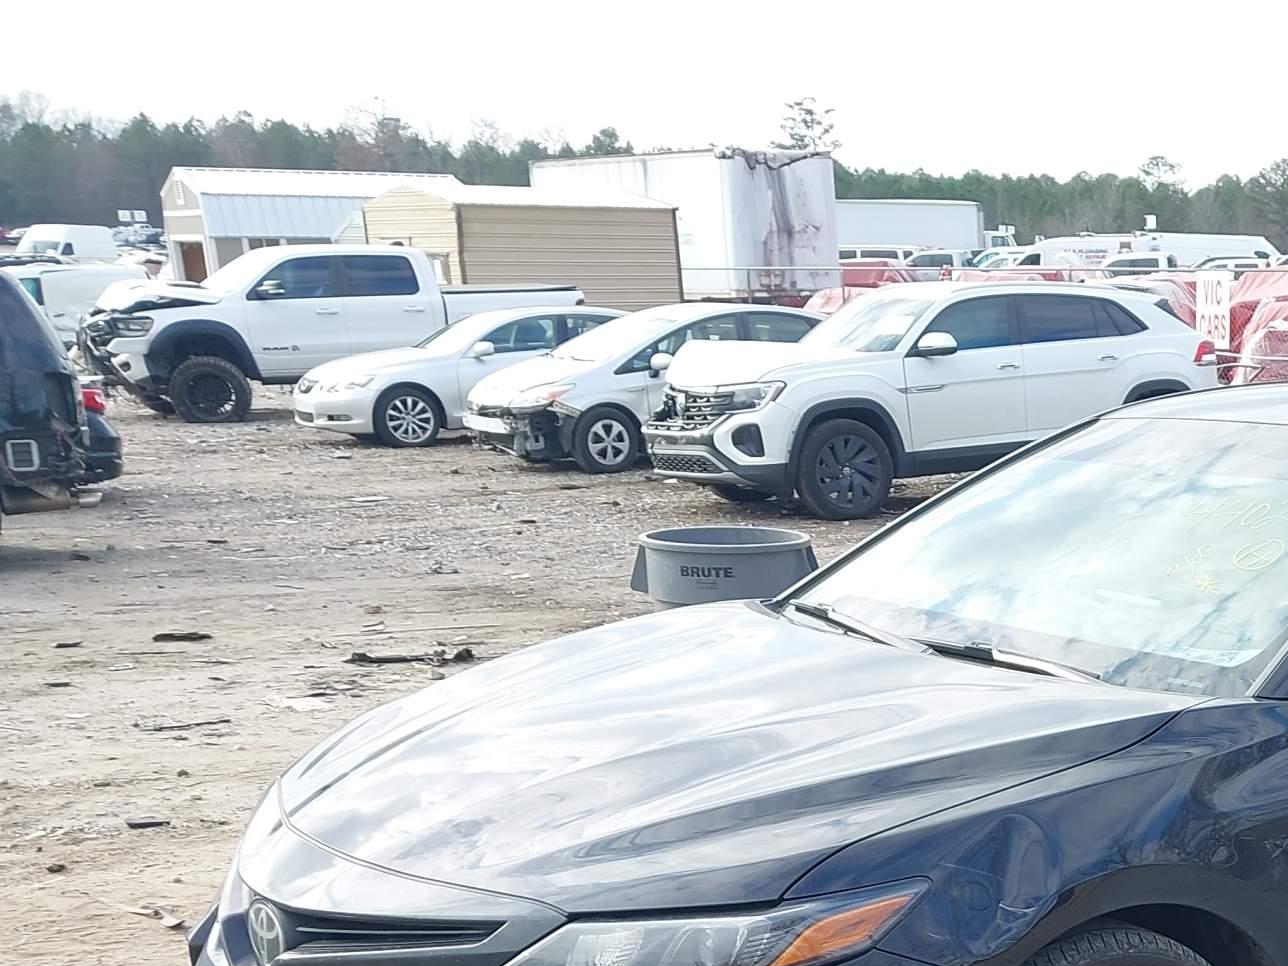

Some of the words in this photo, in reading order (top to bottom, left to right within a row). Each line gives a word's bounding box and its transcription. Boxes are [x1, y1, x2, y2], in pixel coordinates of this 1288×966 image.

[1203, 279, 1222, 305] VIC
[1200, 314, 1227, 340] CARS
[681, 566, 735, 578] BRUTE
